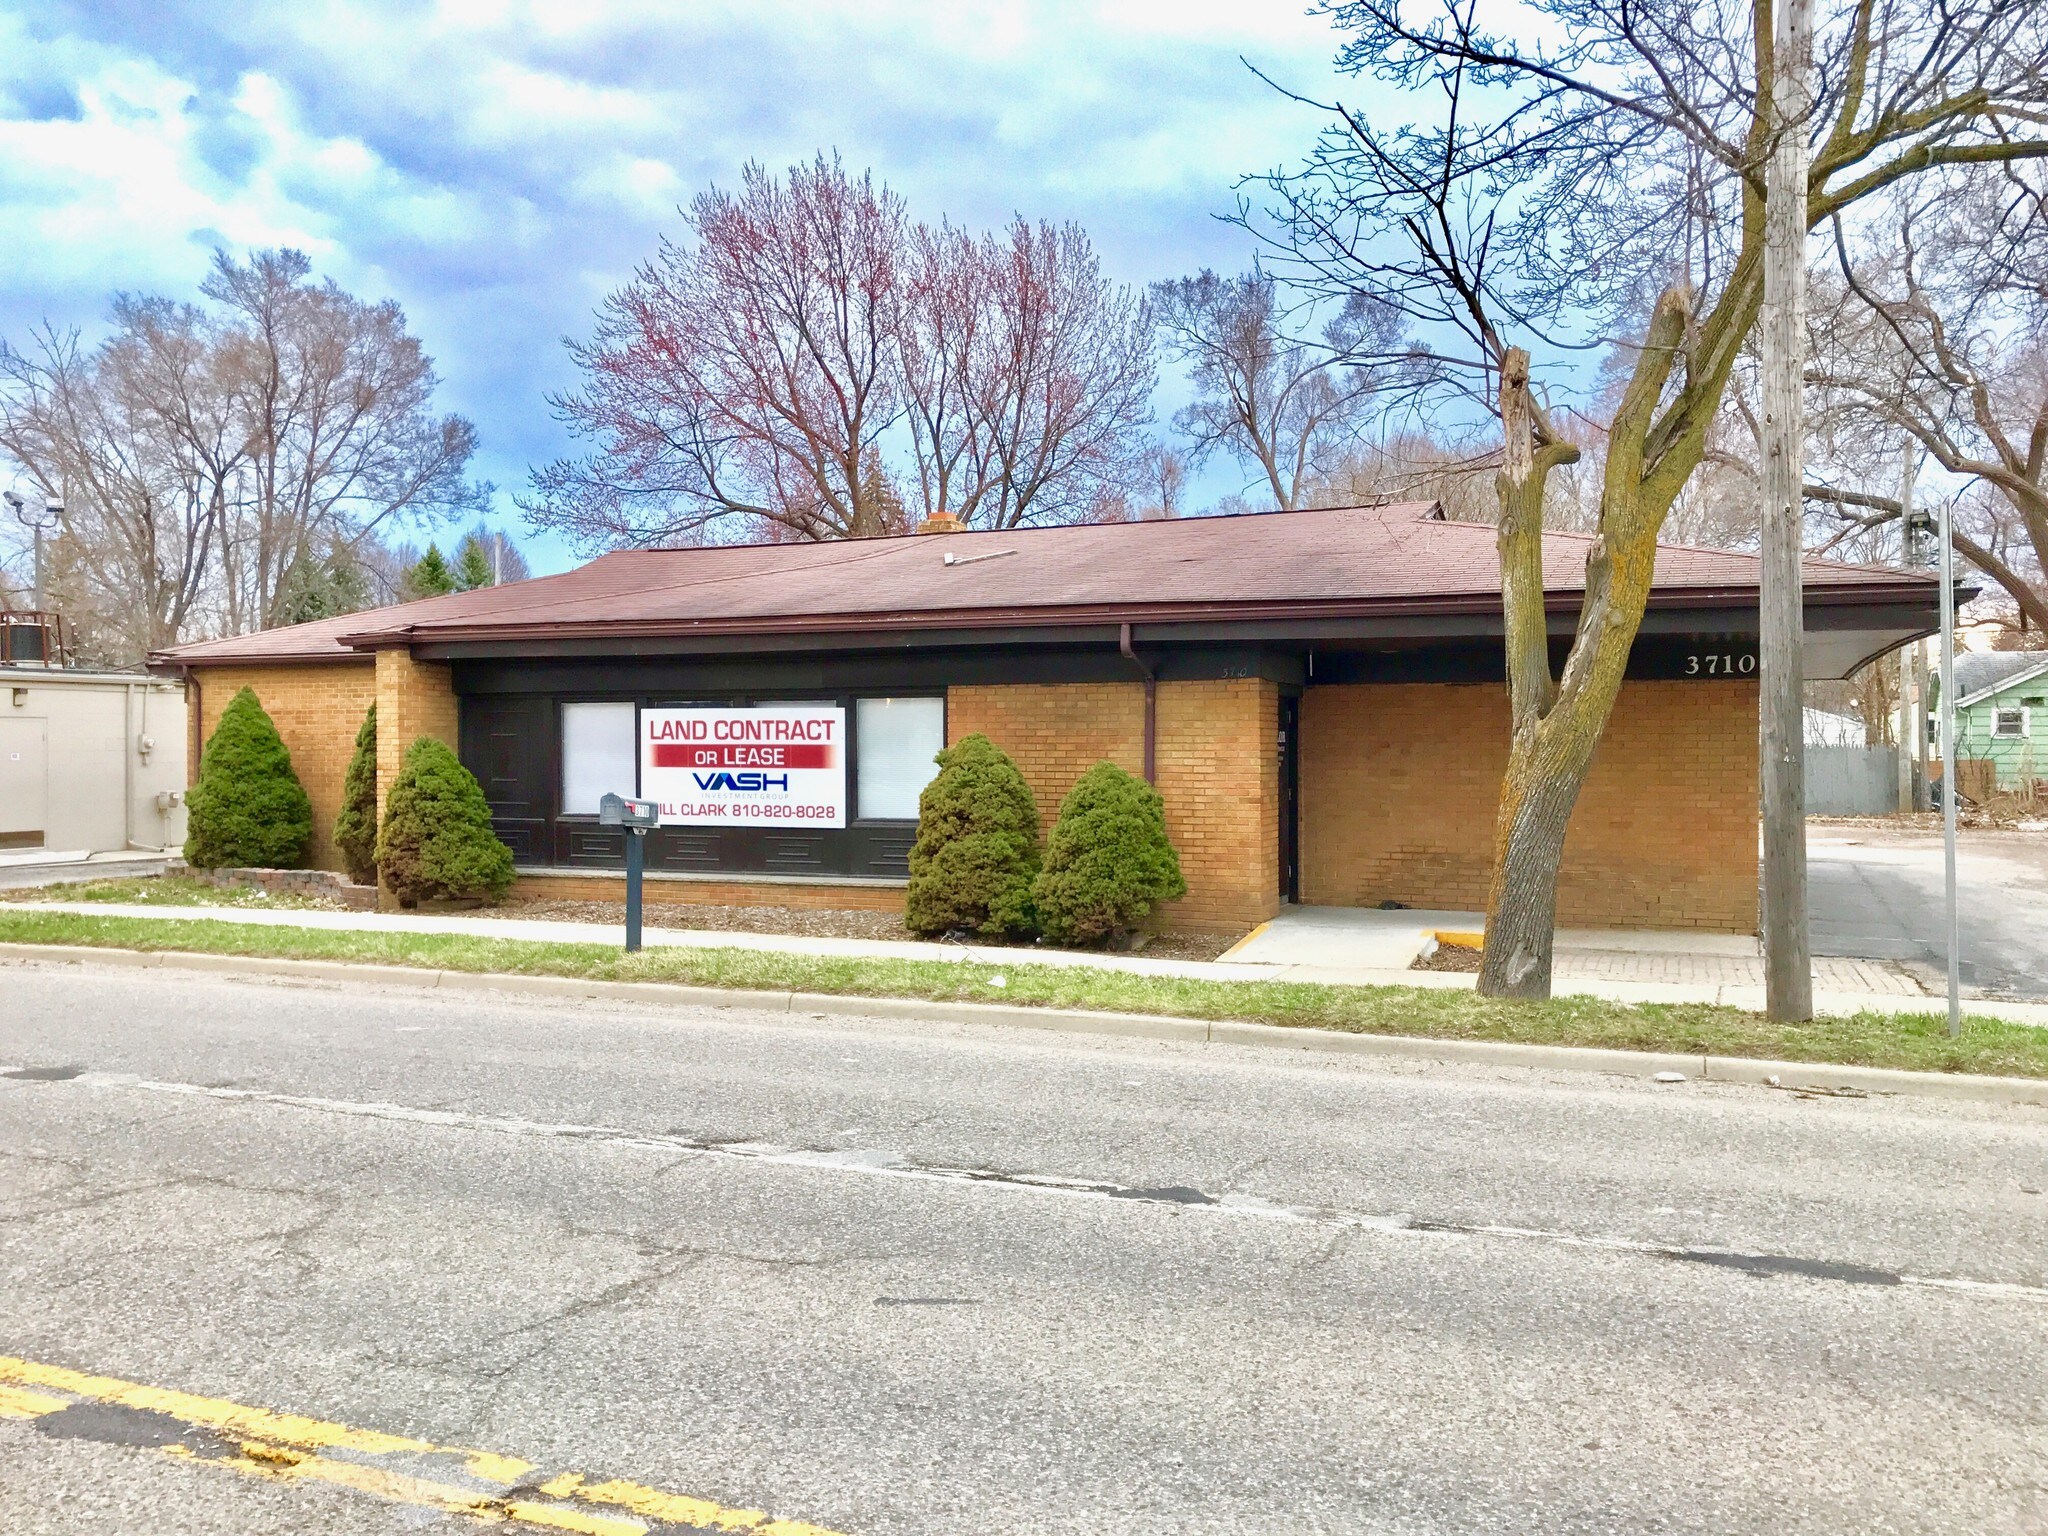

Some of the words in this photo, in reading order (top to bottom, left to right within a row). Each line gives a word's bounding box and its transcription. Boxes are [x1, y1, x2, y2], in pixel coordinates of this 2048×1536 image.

[1685, 654, 1756, 675] 3710
[650, 720, 708, 740] LAND
[714, 719, 836, 741] CONTRACT
[695, 751, 718, 765] OR
[724, 748, 785, 766] LEASE
[692, 772, 788, 792] VASH
[659, 803, 677, 816] ILL
[681, 803, 728, 817] CLARK
[732, 804, 836, 819] 810-820-8028
